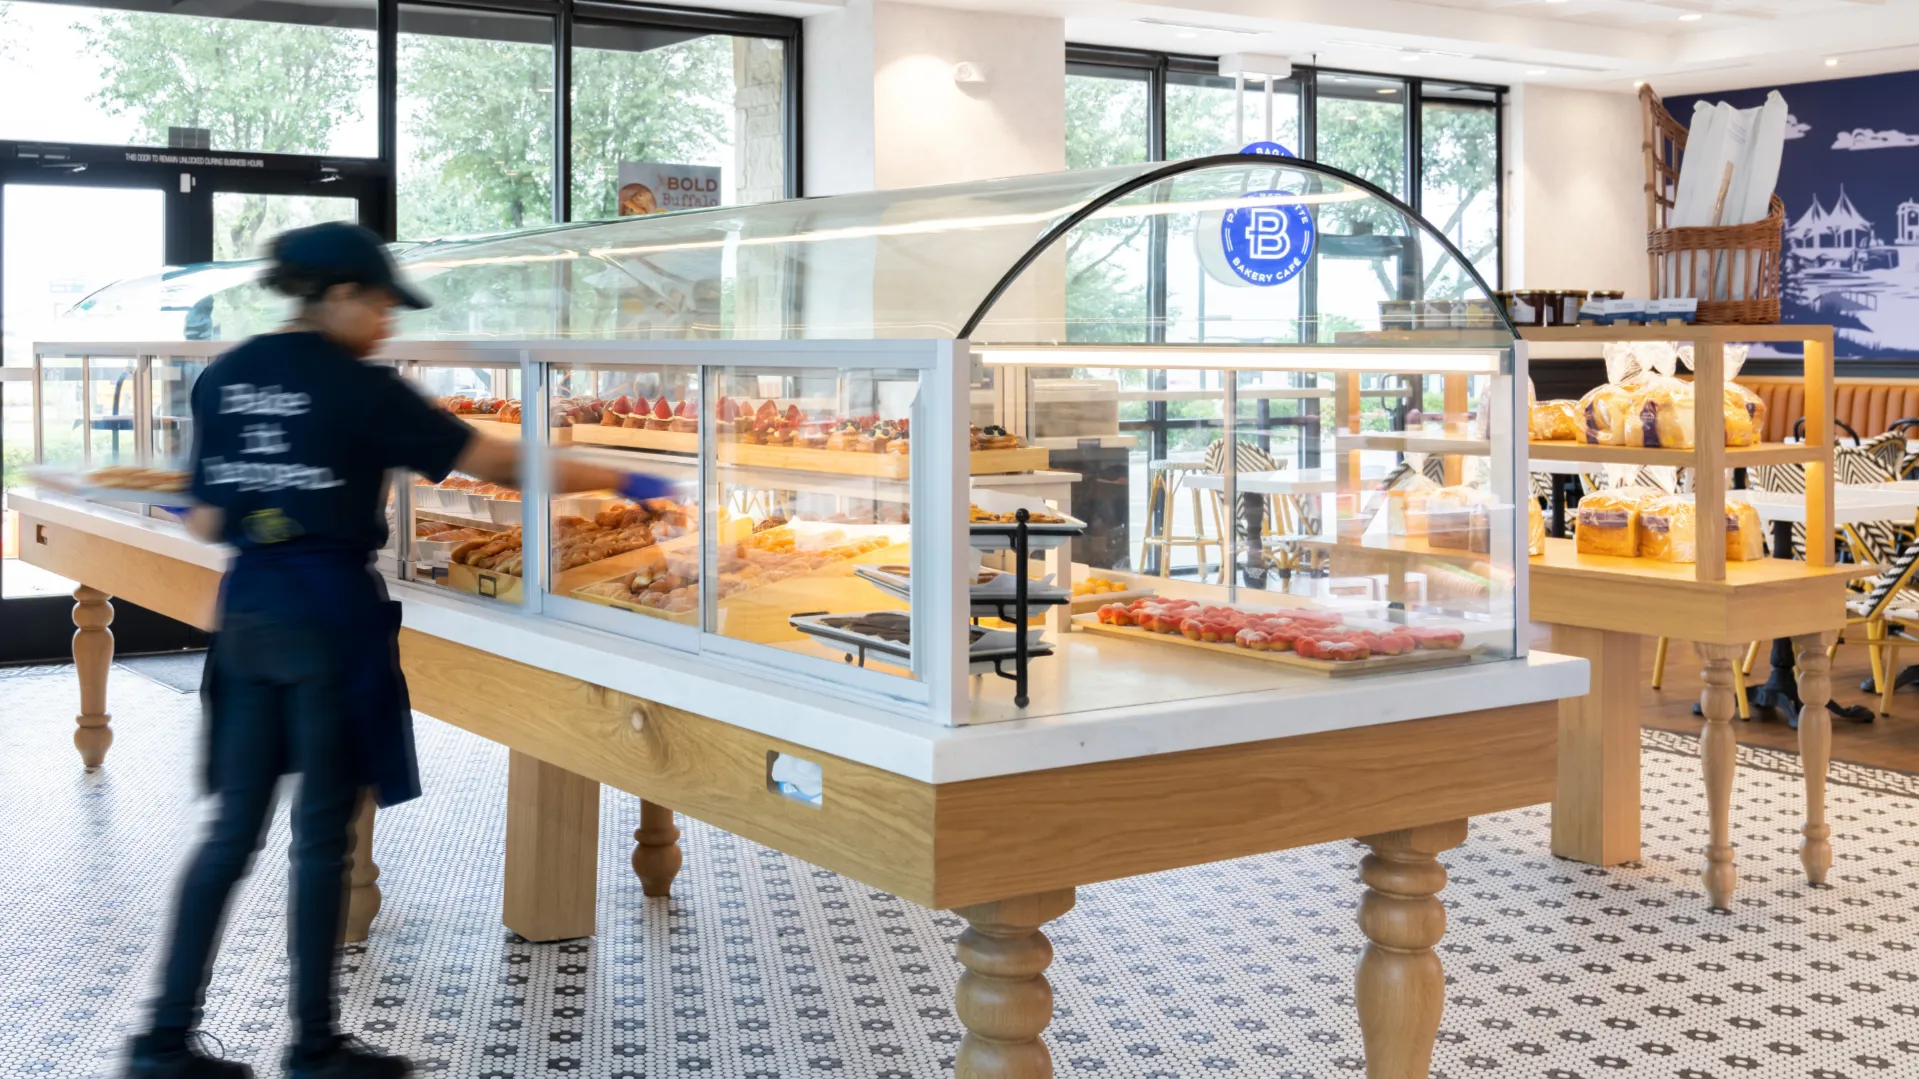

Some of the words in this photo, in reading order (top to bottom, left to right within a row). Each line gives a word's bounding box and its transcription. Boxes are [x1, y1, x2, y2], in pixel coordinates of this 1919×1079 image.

[125, 152, 136, 161] THIS
[137, 153, 151, 162] DOOR
[152, 154, 159, 163] TO
[159, 154, 178, 164] REMAIN
[178, 155, 204, 165] UNLOCKED
[204, 157, 223, 166] DURING
[223, 157, 246, 167] BUSINESS
[247, 159, 264, 168] HOURS
[667, 176, 718, 192] BOLD
[662, 192, 718, 207] Buffalo
[1232, 256, 1273, 283] BAKERY
[1276, 256, 1302, 280] CAFÉ
